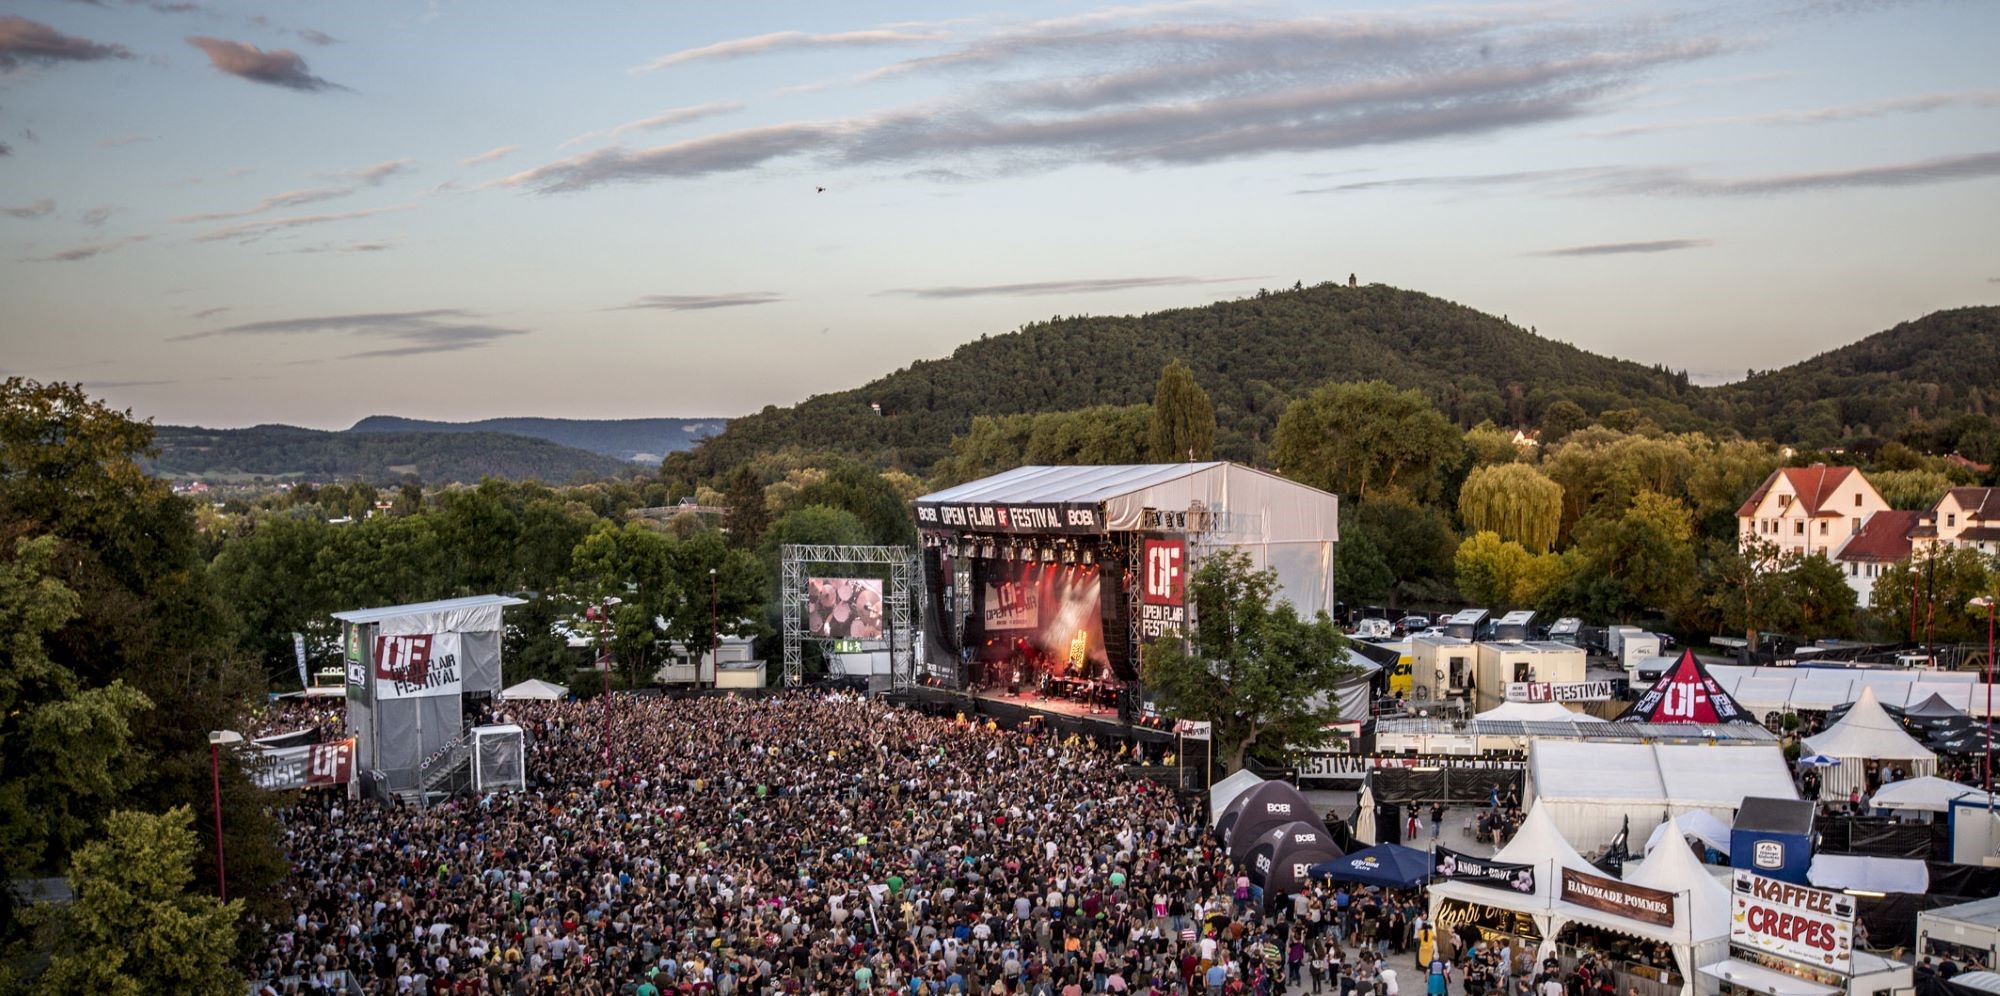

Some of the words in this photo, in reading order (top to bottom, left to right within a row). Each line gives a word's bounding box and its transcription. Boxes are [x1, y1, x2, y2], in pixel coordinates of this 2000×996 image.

[918, 507, 938, 522] BOB!
[941, 507, 966, 526] OPEN
[967, 507, 996, 529] FLAIR
[997, 509, 1008, 526] OF
[1010, 508, 1062, 531] FESTIVAL
[1068, 510, 1094, 526] BOB!
[1149, 547, 1180, 599] OF
[1143, 604, 1162, 620] OPEN
[1163, 606, 1184, 622] FLAIR
[1143, 619, 1183, 639] FESTIVAL
[381, 637, 426, 672] OF
[395, 668, 460, 696] FESTIVAL
[1530, 684, 1548, 700] OF
[1553, 681, 1611, 700] FESTIVAL
[1664, 682, 1706, 718] OF
[313, 745, 348, 782] OF
[1301, 757, 1369, 774] ESTIVAL
[1267, 803, 1291, 813] BOB!
[1295, 833, 1316, 842] BOB!
[1458, 861, 1482, 876] KNOBI
[1567, 879, 1623, 904] HANDMADE
[1624, 894, 1667, 914] POMMES
[1753, 876, 1833, 915] KAFFEE
[1747, 905, 1836, 951] CREPES
